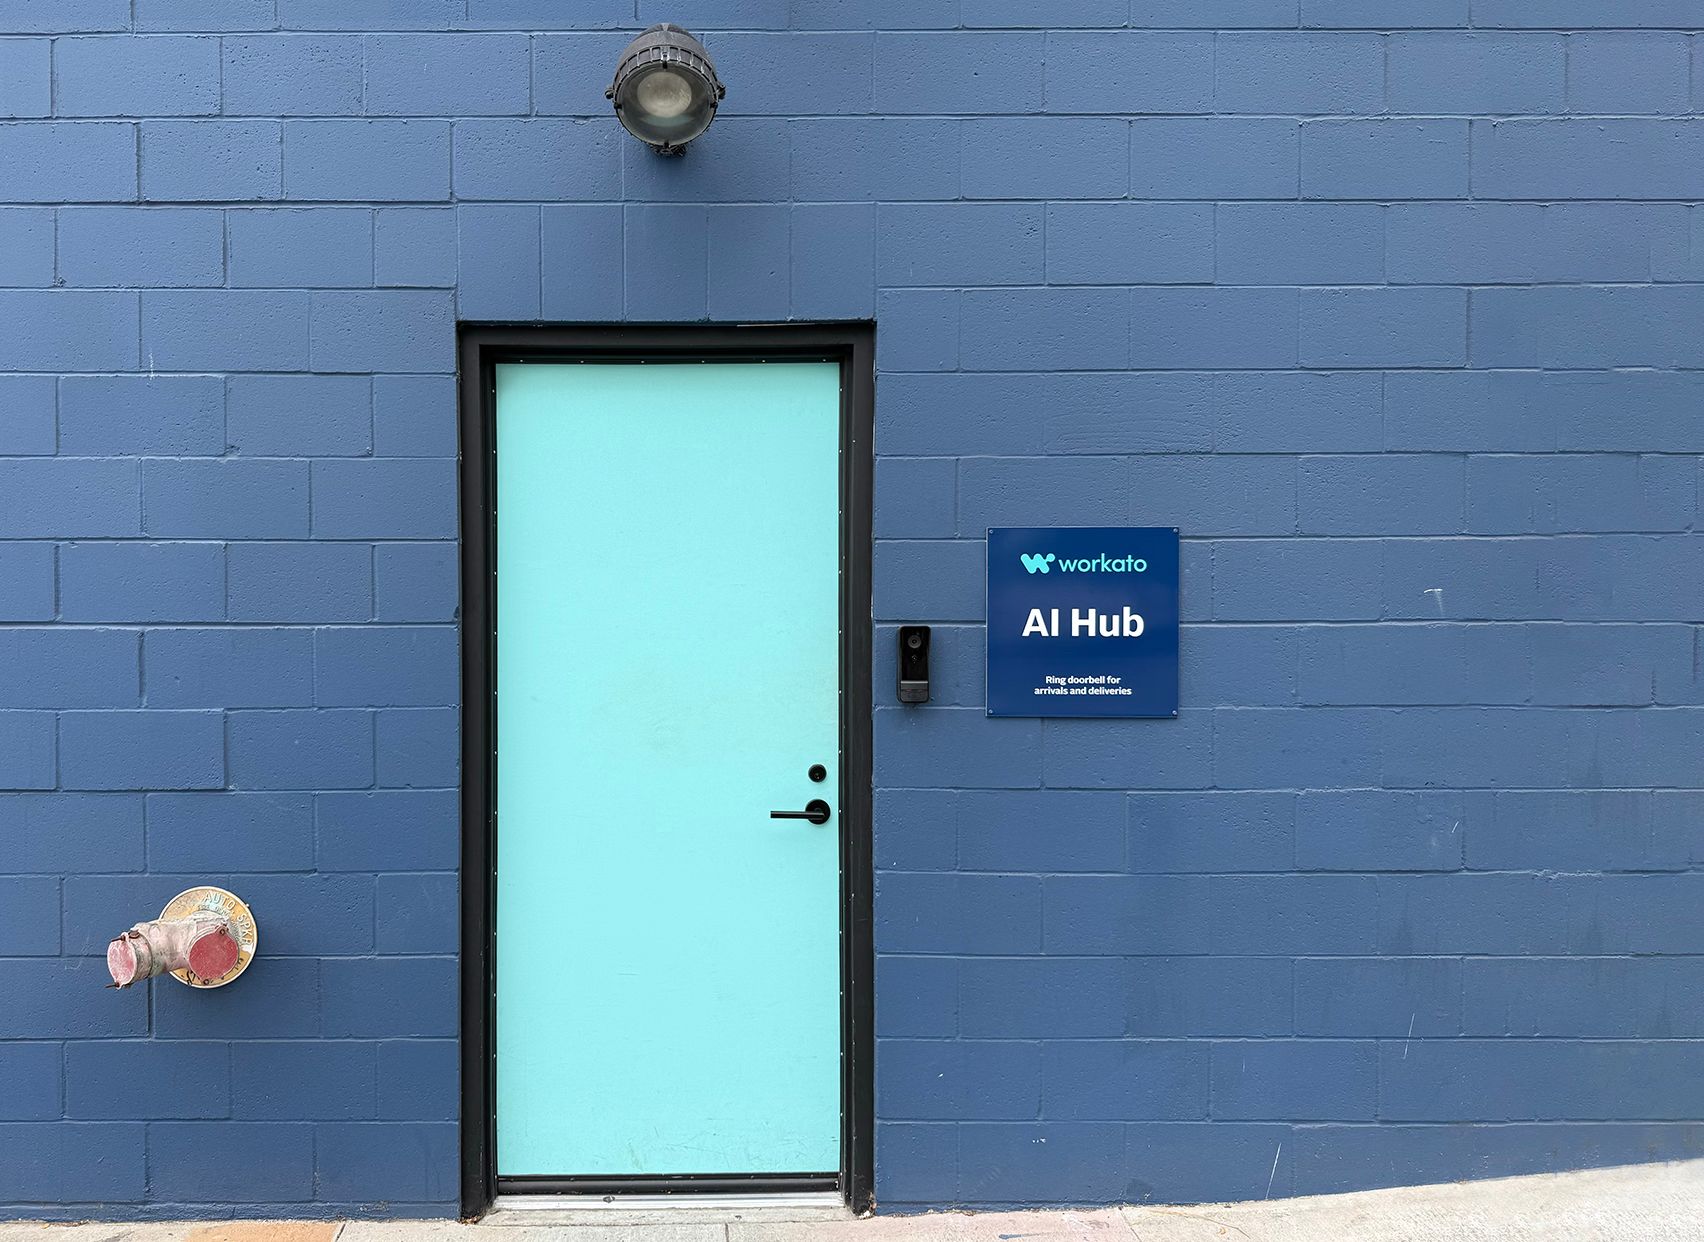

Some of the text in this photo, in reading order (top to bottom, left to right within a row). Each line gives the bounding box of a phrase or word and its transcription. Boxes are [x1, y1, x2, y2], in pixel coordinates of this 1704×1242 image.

[1058, 553, 1148, 573] workato
[1021, 606, 1145, 637] AI Hub
[1045, 675, 1122, 685] Ring doorbell for
[1034, 686, 1133, 695] arrivals and deliveries
